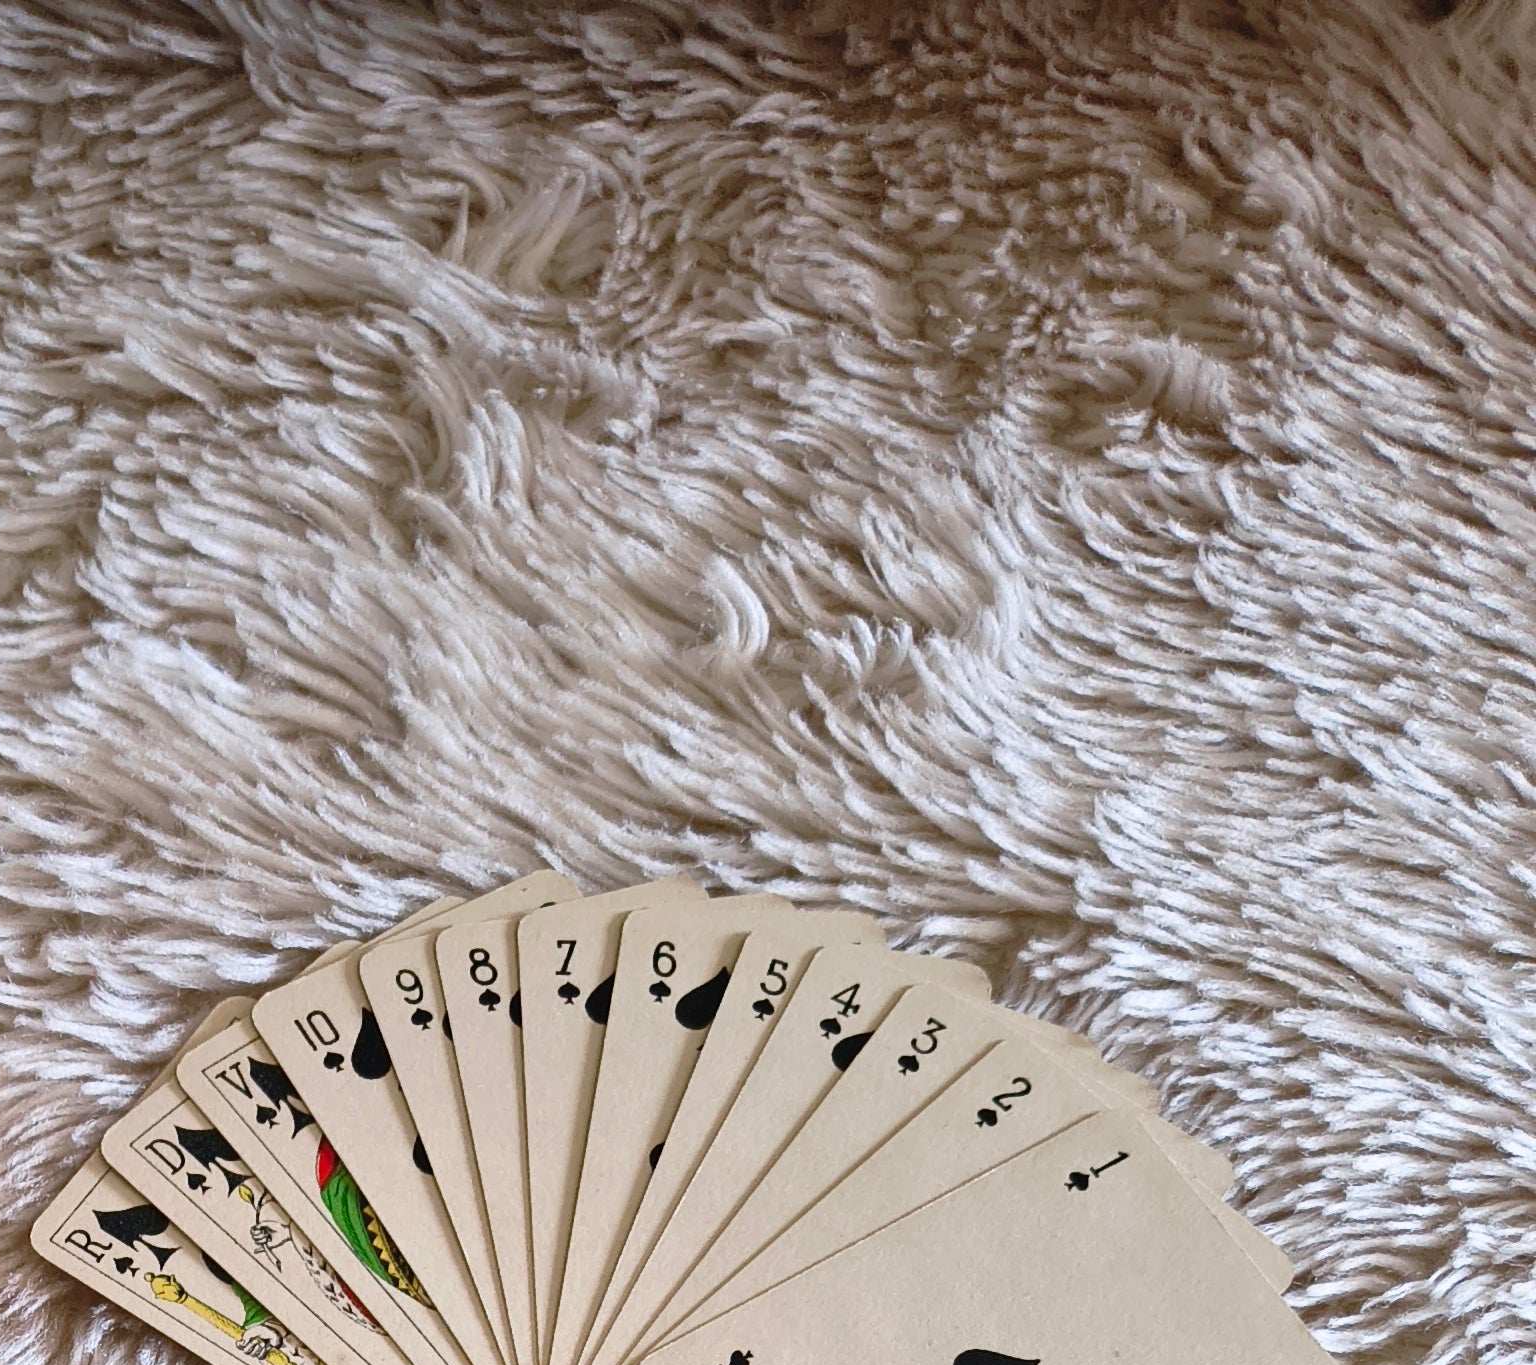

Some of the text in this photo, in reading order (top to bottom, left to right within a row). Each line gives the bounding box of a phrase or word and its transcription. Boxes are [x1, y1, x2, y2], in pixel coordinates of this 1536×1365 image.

[468, 947, 498, 987] 8
[555, 939, 577, 976] 7
[652, 940, 677, 978] 6
[395, 968, 424, 1005] 9
[759, 958, 789, 996] 5
[830, 983, 861, 1018] 4
[293, 1010, 340, 1052] 10
[910, 1017, 947, 1055] 3
[214, 1061, 254, 1100] V
[991, 1076, 1032, 1112] 2
[144, 1138, 186, 1175] D
[64, 1229, 113, 1264] R
